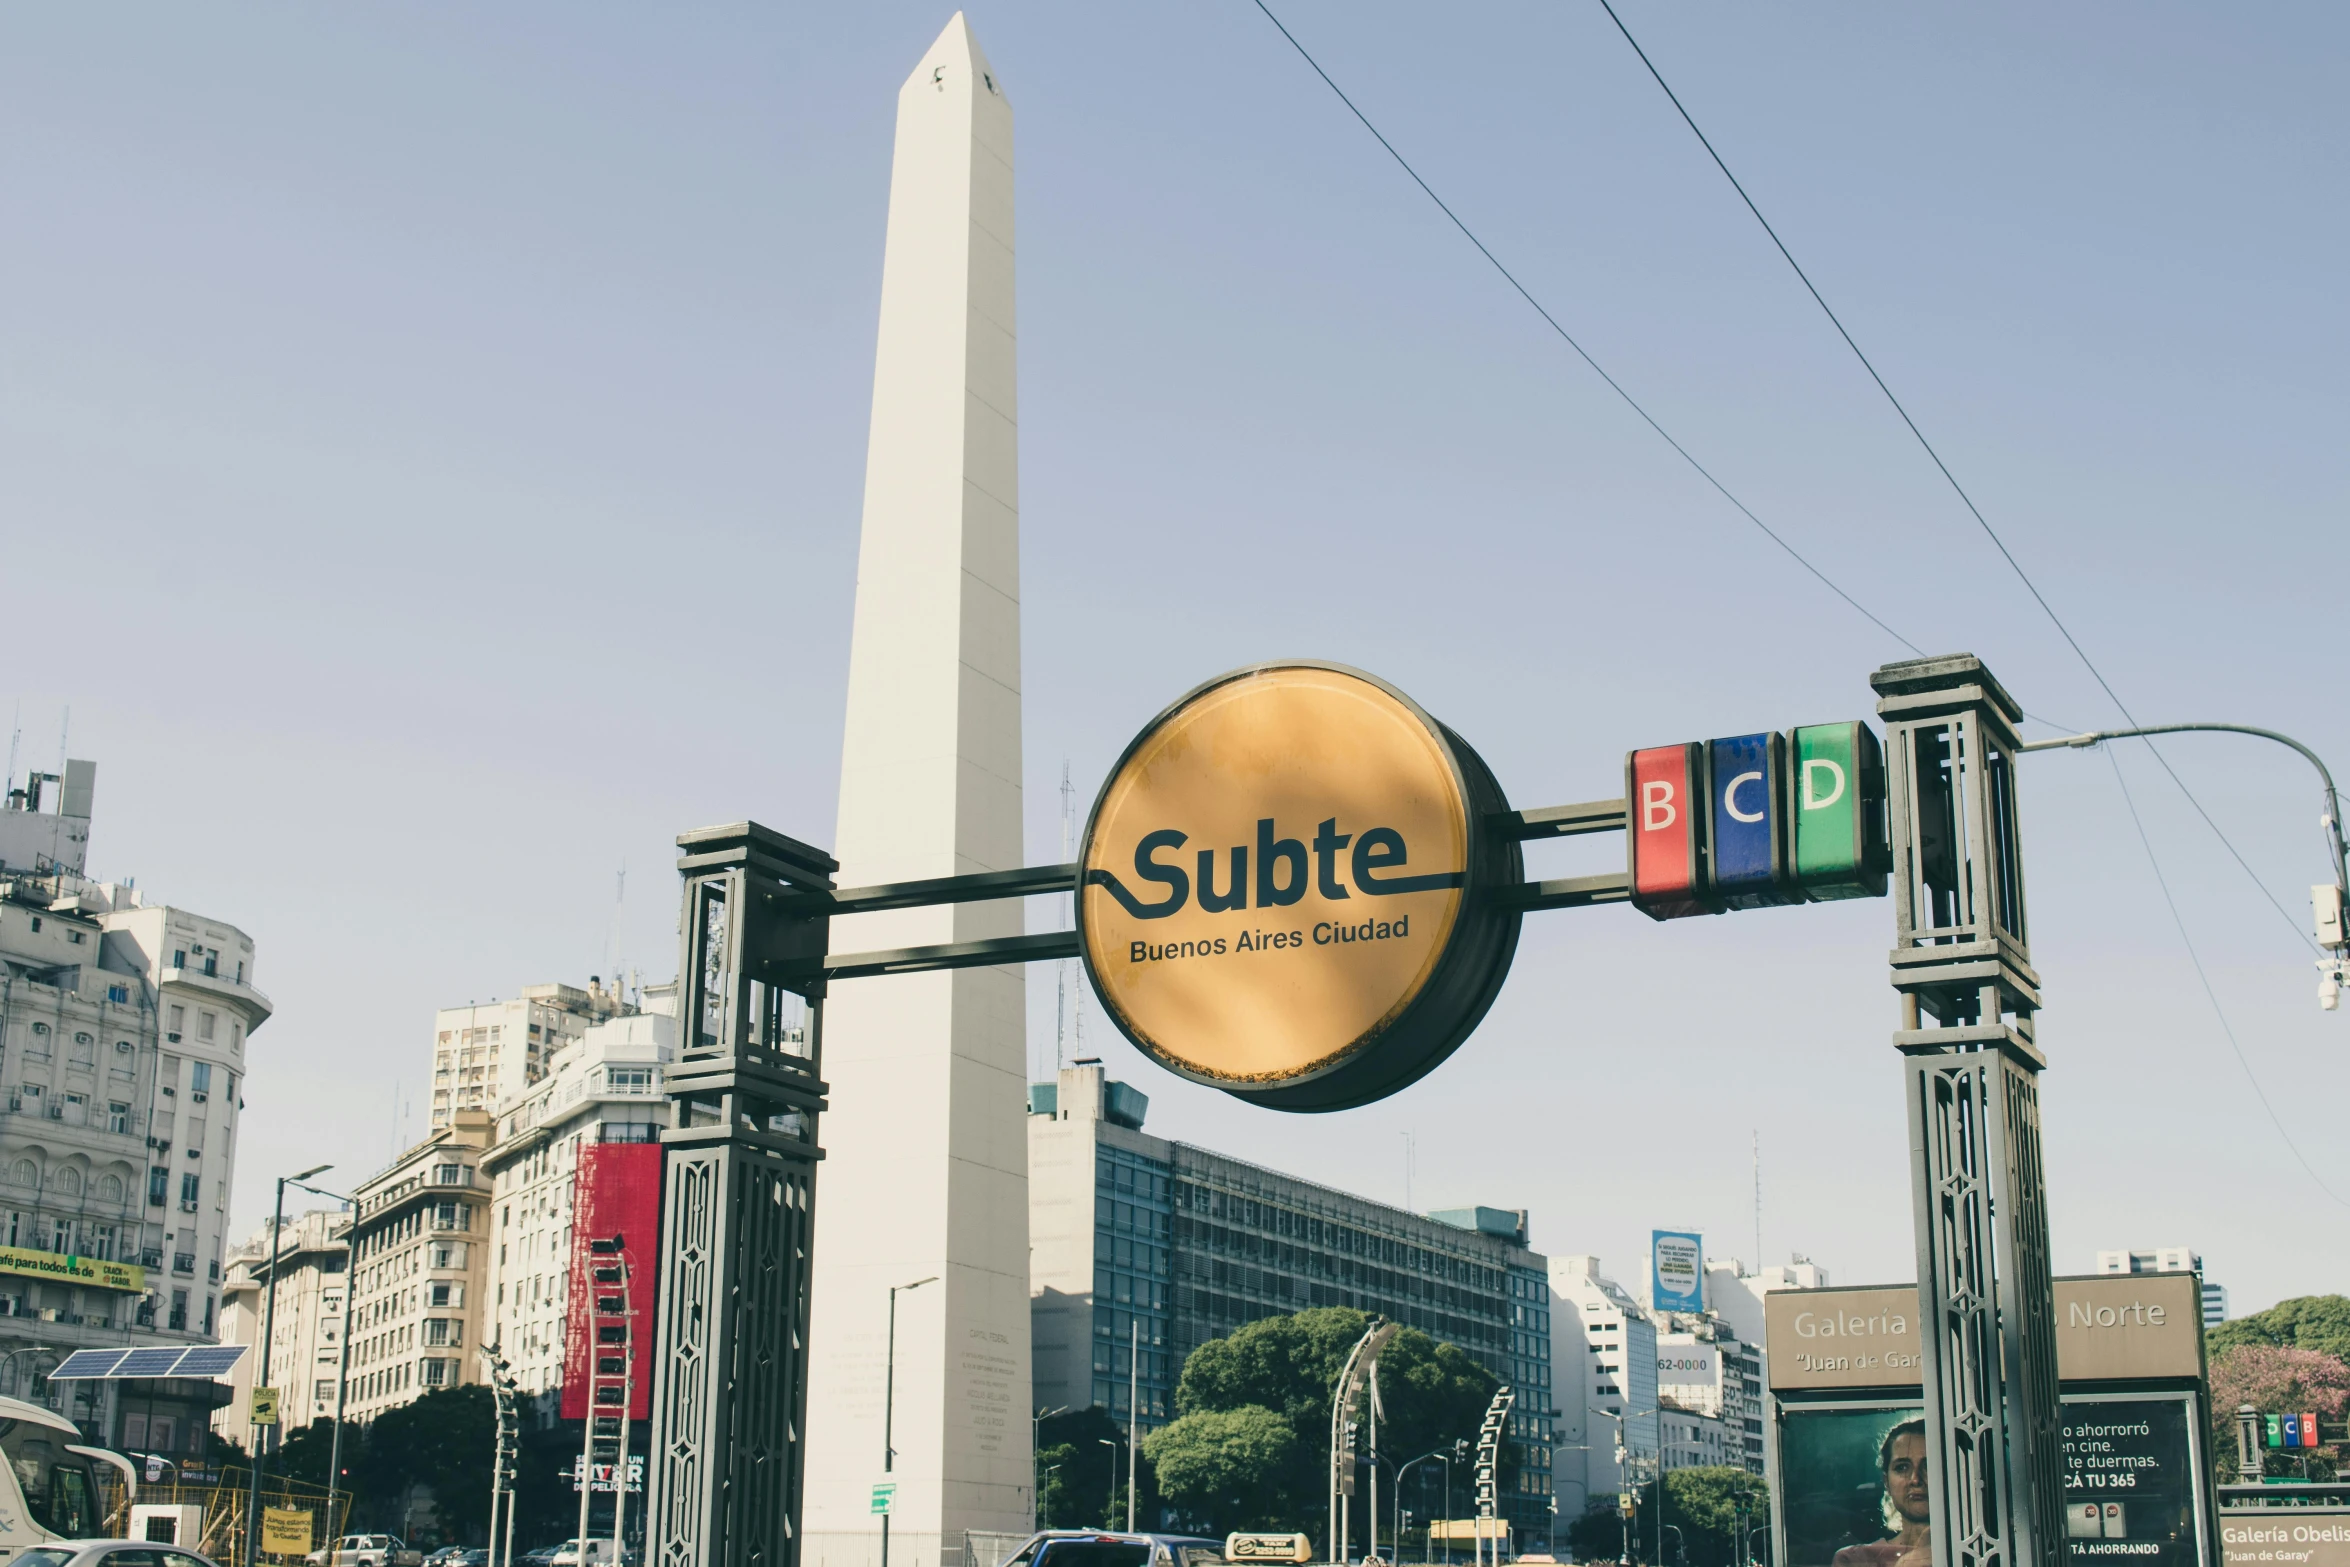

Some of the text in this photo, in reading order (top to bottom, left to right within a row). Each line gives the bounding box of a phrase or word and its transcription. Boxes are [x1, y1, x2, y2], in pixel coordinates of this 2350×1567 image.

[1643, 758, 1846, 832] B C D
[1102, 816, 1440, 920] Subte
[1130, 914, 1409, 963] Buenos Aires Ciudad
[15, 1259, 38, 1269] para
[39, 1260, 68, 1274] todos
[69, 1267, 80, 1275] es
[81, 1266, 94, 1277] de
[1795, 1307, 1907, 1338] Galería
[2069, 1300, 2167, 1328] Norte
[1855, 1351, 1879, 1369] de
[1884, 1351, 1921, 1368] Gar
[2076, 1420, 2150, 1437] ahorrorró
[2285, 1422, 2296, 1434] C
[2303, 1421, 2313, 1433] B
[2079, 1438, 2115, 1452] cine.
[628, 1456, 644, 1465] UN
[2068, 1454, 2160, 1468] te duermas.
[2085, 1474, 2105, 1487] TU
[2109, 1473, 2136, 1487] 365
[2223, 1526, 2289, 1543] Galería
[2070, 1542, 2159, 1555] TÁ AHORRANDO
[2258, 1551, 2273, 1561] de
